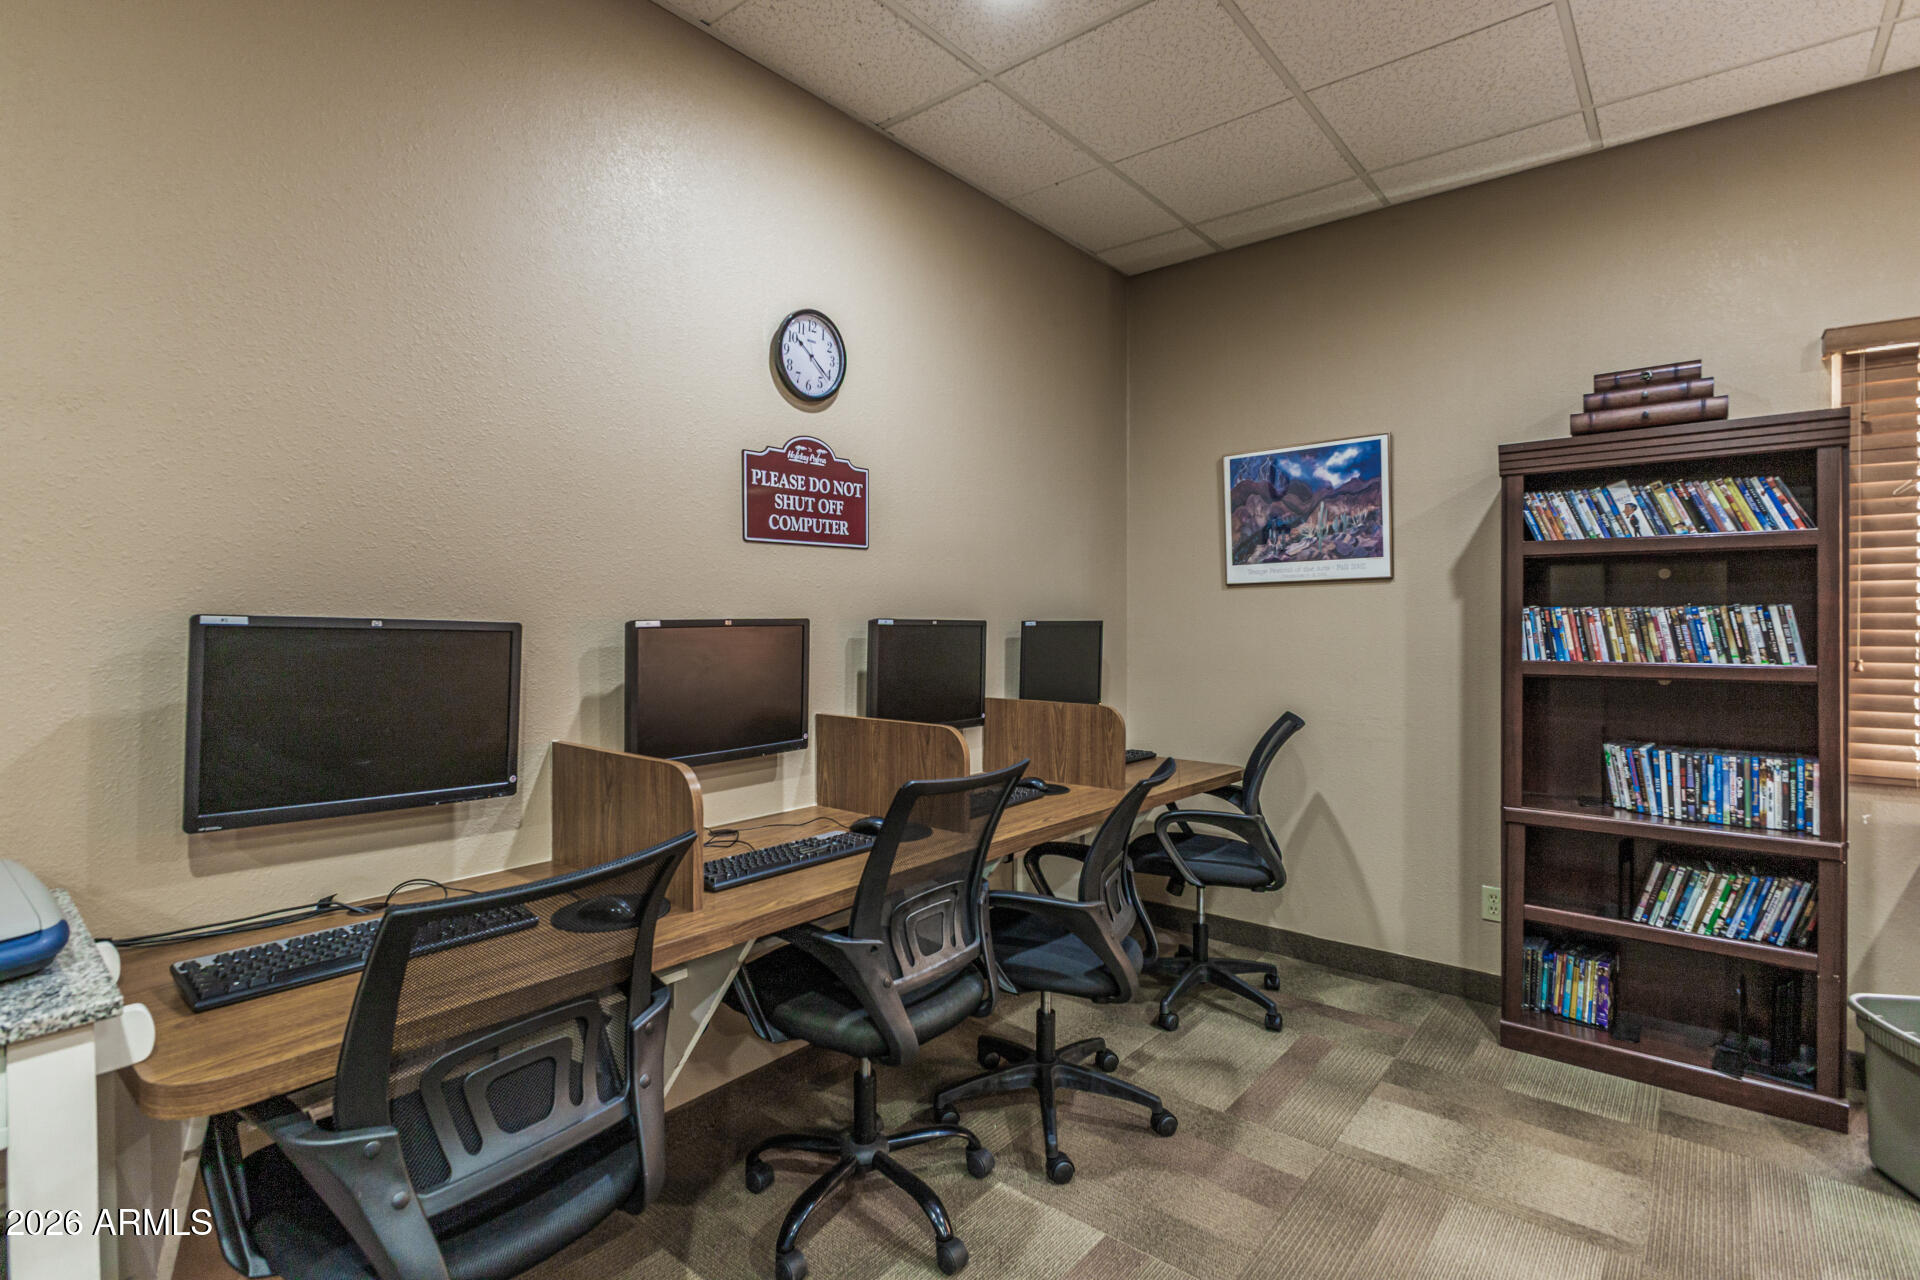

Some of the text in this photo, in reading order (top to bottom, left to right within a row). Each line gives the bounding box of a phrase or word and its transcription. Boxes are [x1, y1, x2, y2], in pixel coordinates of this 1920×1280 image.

[798, 321, 805, 335] 11
[808, 320, 817, 333] 12
[788, 330, 798, 343] 10
[783, 343, 790, 355] 9
[827, 342, 832, 353] 2
[786, 359, 793, 371] 8
[829, 356, 835, 367] 3
[795, 371, 801, 383] 7
[817, 376, 823, 389] 5
[805, 380, 812, 391] 6
[751, 468, 863, 498] PLEASE DO NOT
[774, 493, 844, 515] SHUT OFF
[768, 514, 850, 536] COMPUTER
